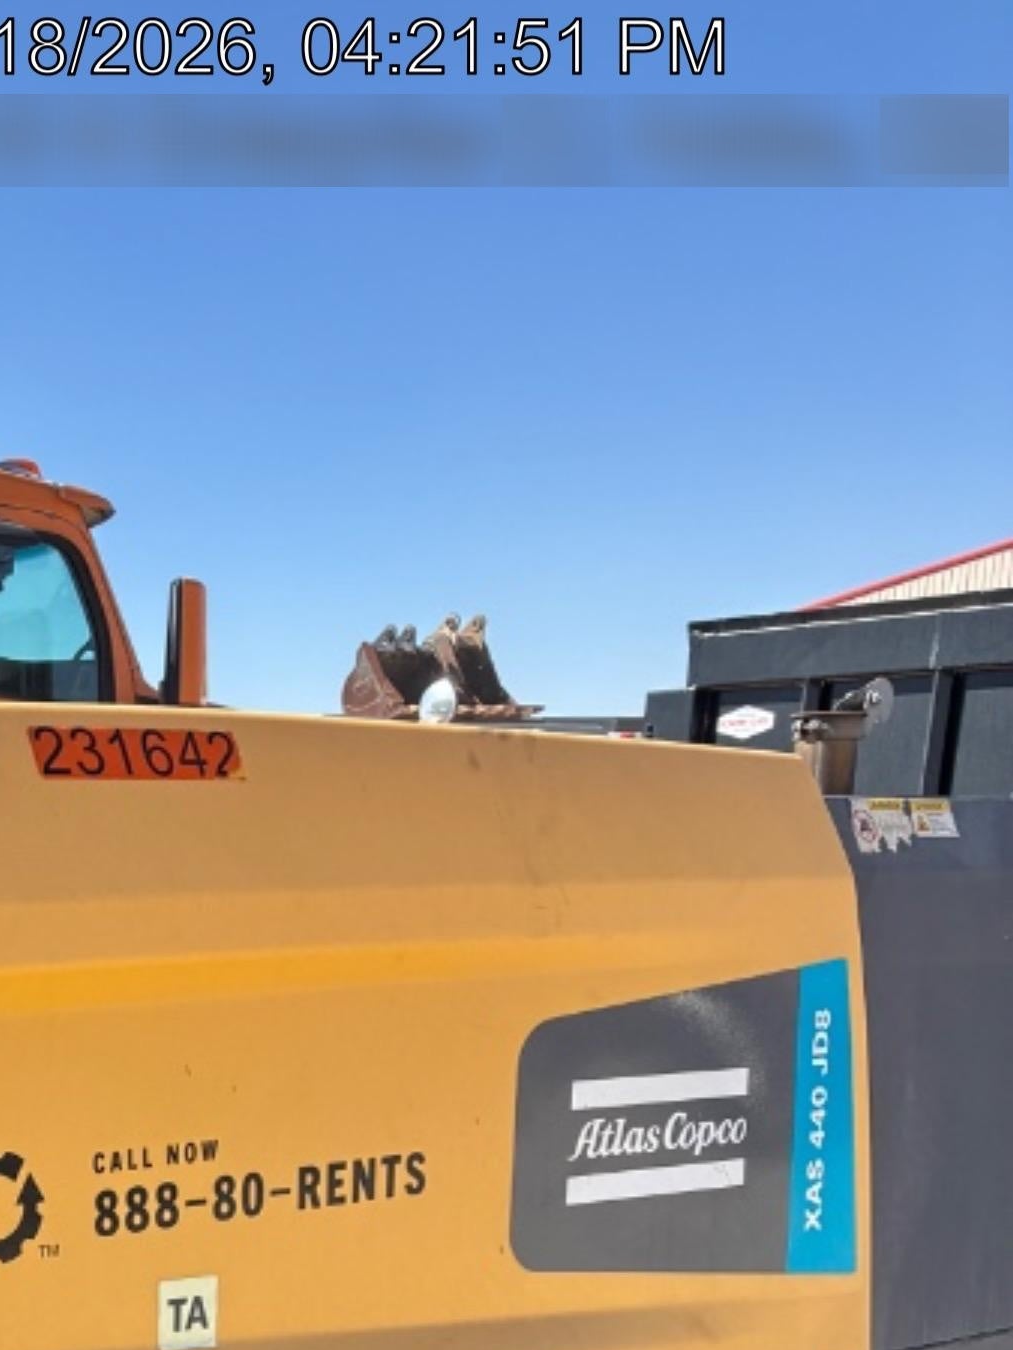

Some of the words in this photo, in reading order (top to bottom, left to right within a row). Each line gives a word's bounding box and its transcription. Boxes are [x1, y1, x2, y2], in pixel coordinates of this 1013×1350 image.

[34, 726, 235, 777] 231642
[811, 1008, 831, 1076] JD8
[568, 1118, 660, 1162] Atlas
[664, 1111, 747, 1155] Copco
[809, 1085, 828, 1149] 440
[93, 1147, 153, 1174] CALL
[166, 1139, 219, 1165] NOW
[94, 1151, 426, 1237] 888-80-RENTS
[804, 1158, 825, 1231] XAS
[167, 1295, 208, 1332] TA
